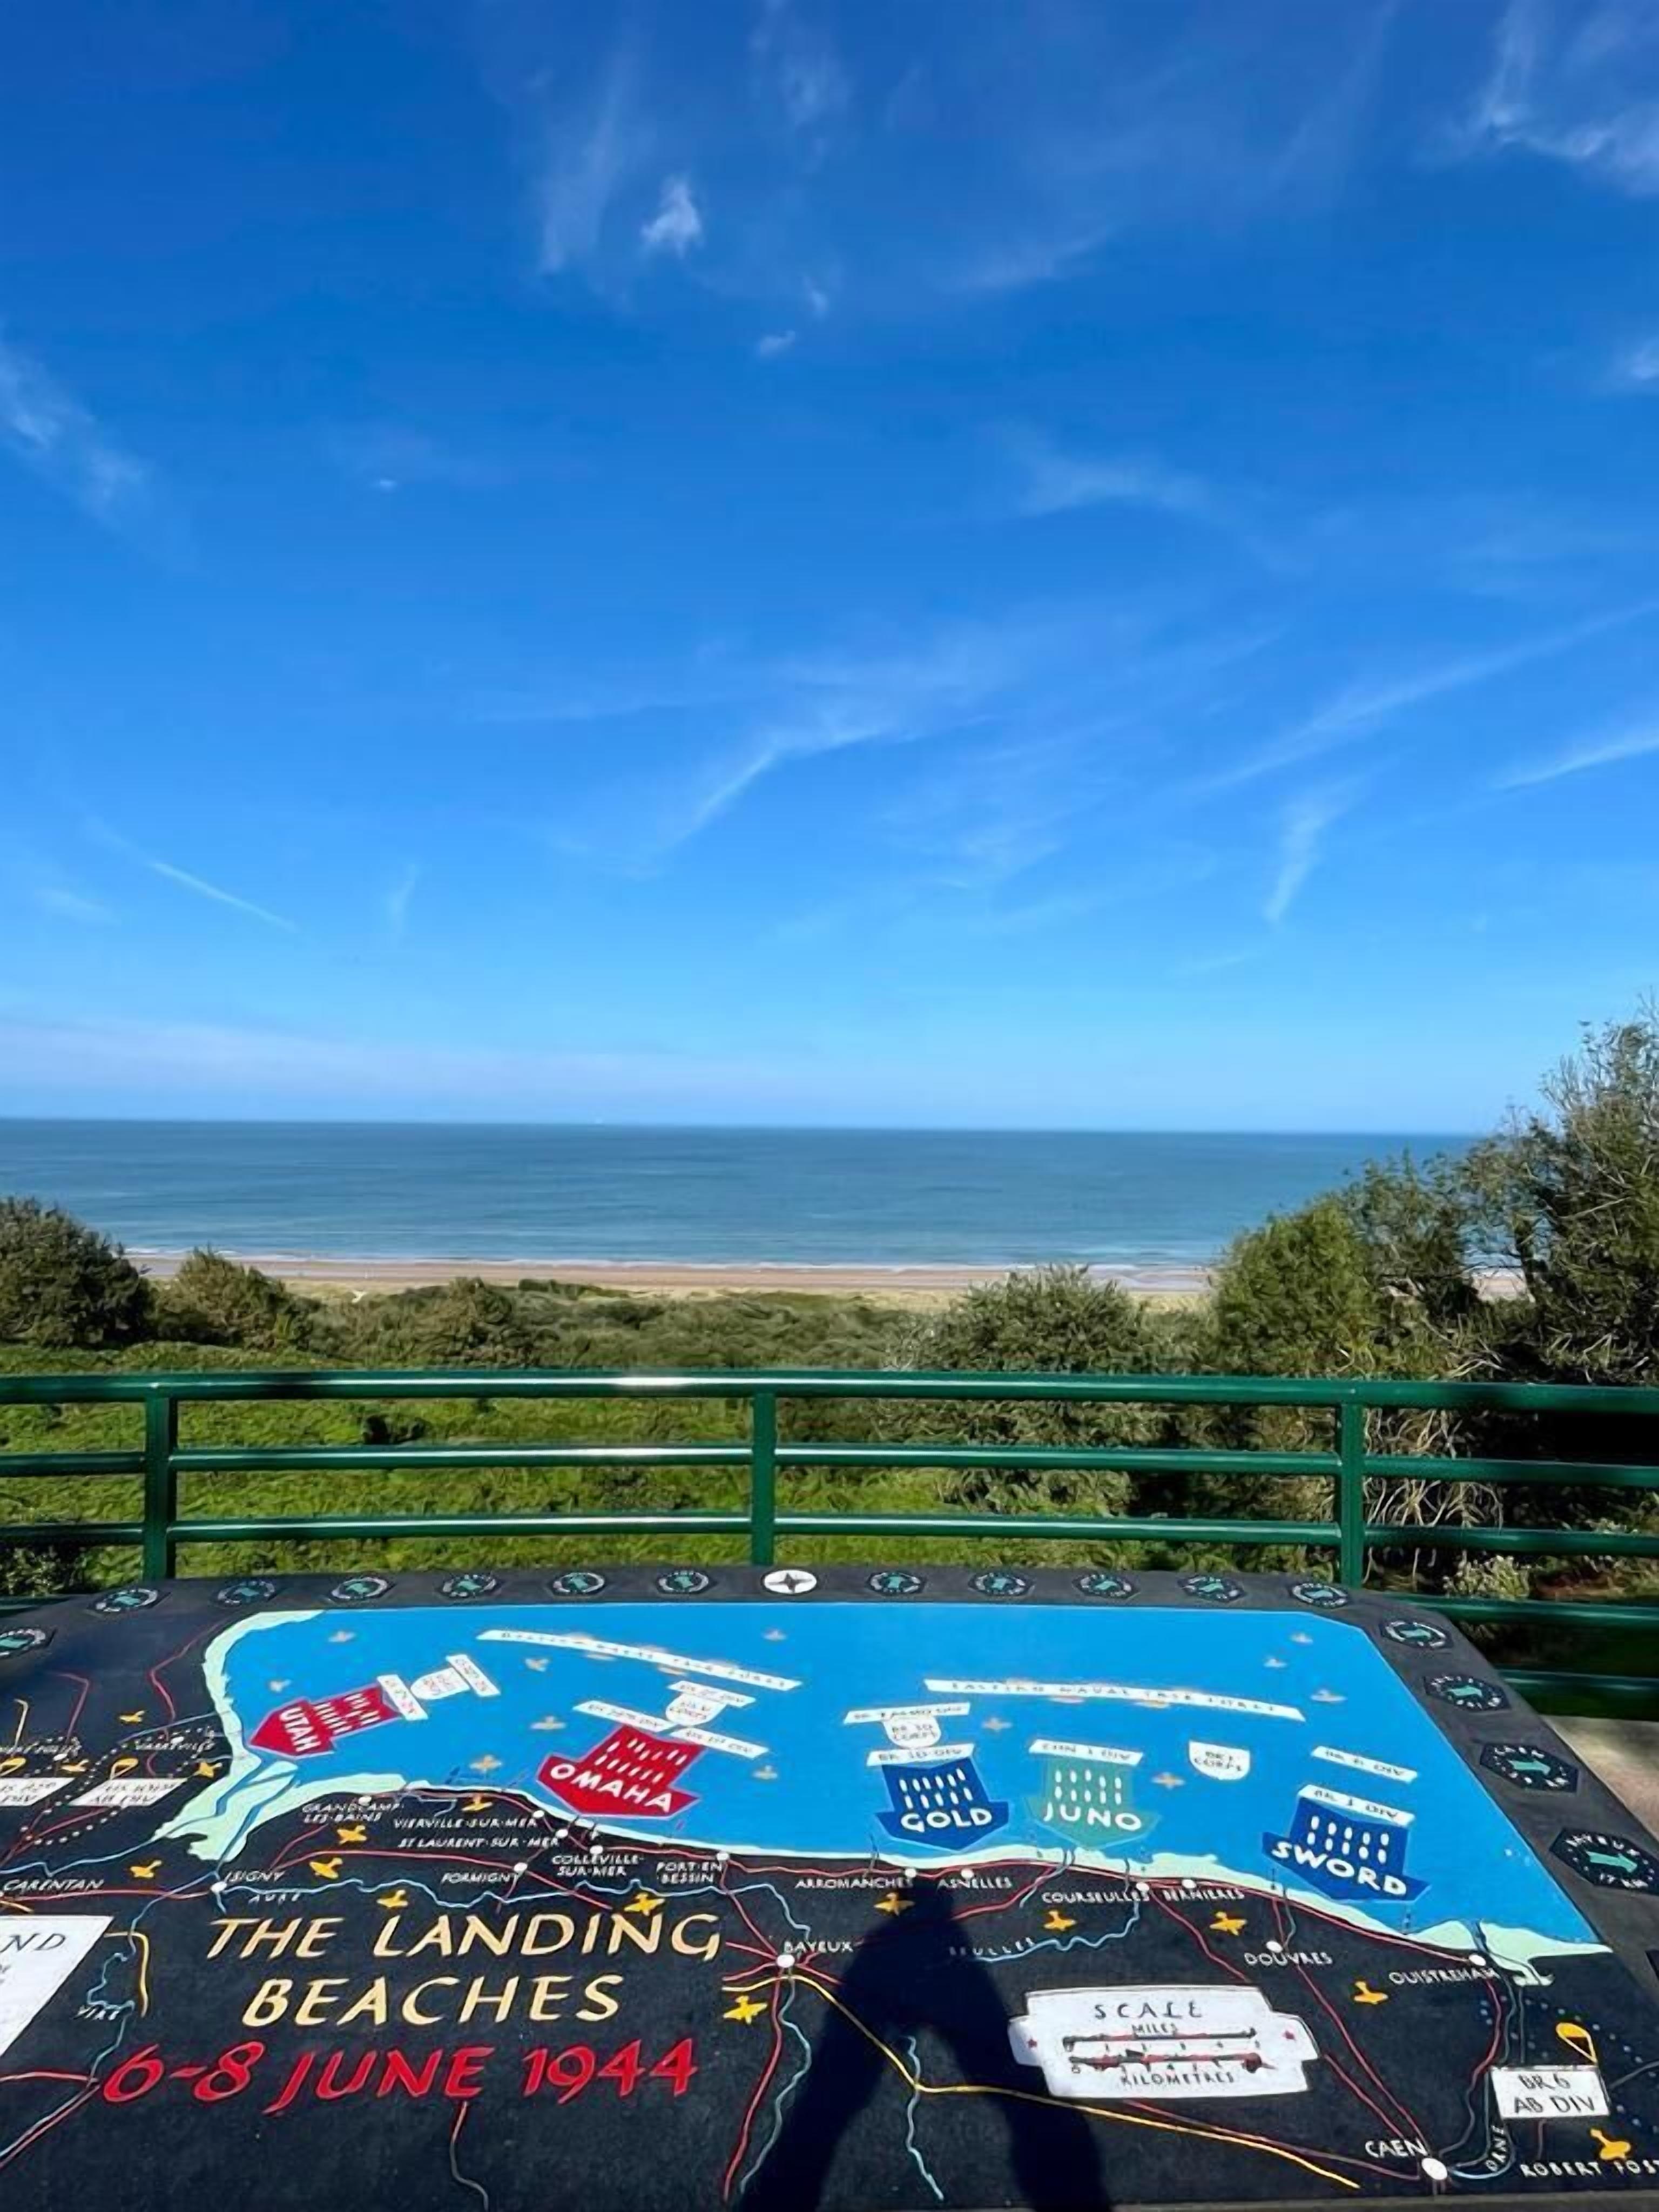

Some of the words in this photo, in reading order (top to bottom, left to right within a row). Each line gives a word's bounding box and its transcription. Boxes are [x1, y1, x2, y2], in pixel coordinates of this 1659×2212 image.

[279, 1707, 322, 1752] UTAH
[550, 1764, 673, 1812] OMAHA
[901, 1807, 993, 1833] GOLD
[1043, 1802, 1142, 1831] JUNO
[1271, 1840, 1407, 1896] SWORD
[206, 1917, 345, 1959] THE
[373, 1913, 722, 1961] LANDING
[783, 1941, 854, 1953] BAYEUX
[1243, 1952, 1333, 1967] DOUVRES
[1389, 1967, 1500, 1985] OUISTREHAM
[242, 1977, 624, 2027] BEACHES
[103, 2040, 266, 2102] 6-8
[262, 2046, 496, 2118] JUNE
[521, 2038, 698, 2104] 1944
[1518, 2074, 1552, 2090] BR
[1554, 2076, 1572, 2089] 6
[1513, 2096, 1544, 2114] AB
[1552, 2094, 1596, 2112] DIV
[1364, 2138, 1429, 2158] CAEN
[1520, 2162, 1602, 2177] ROBERT
